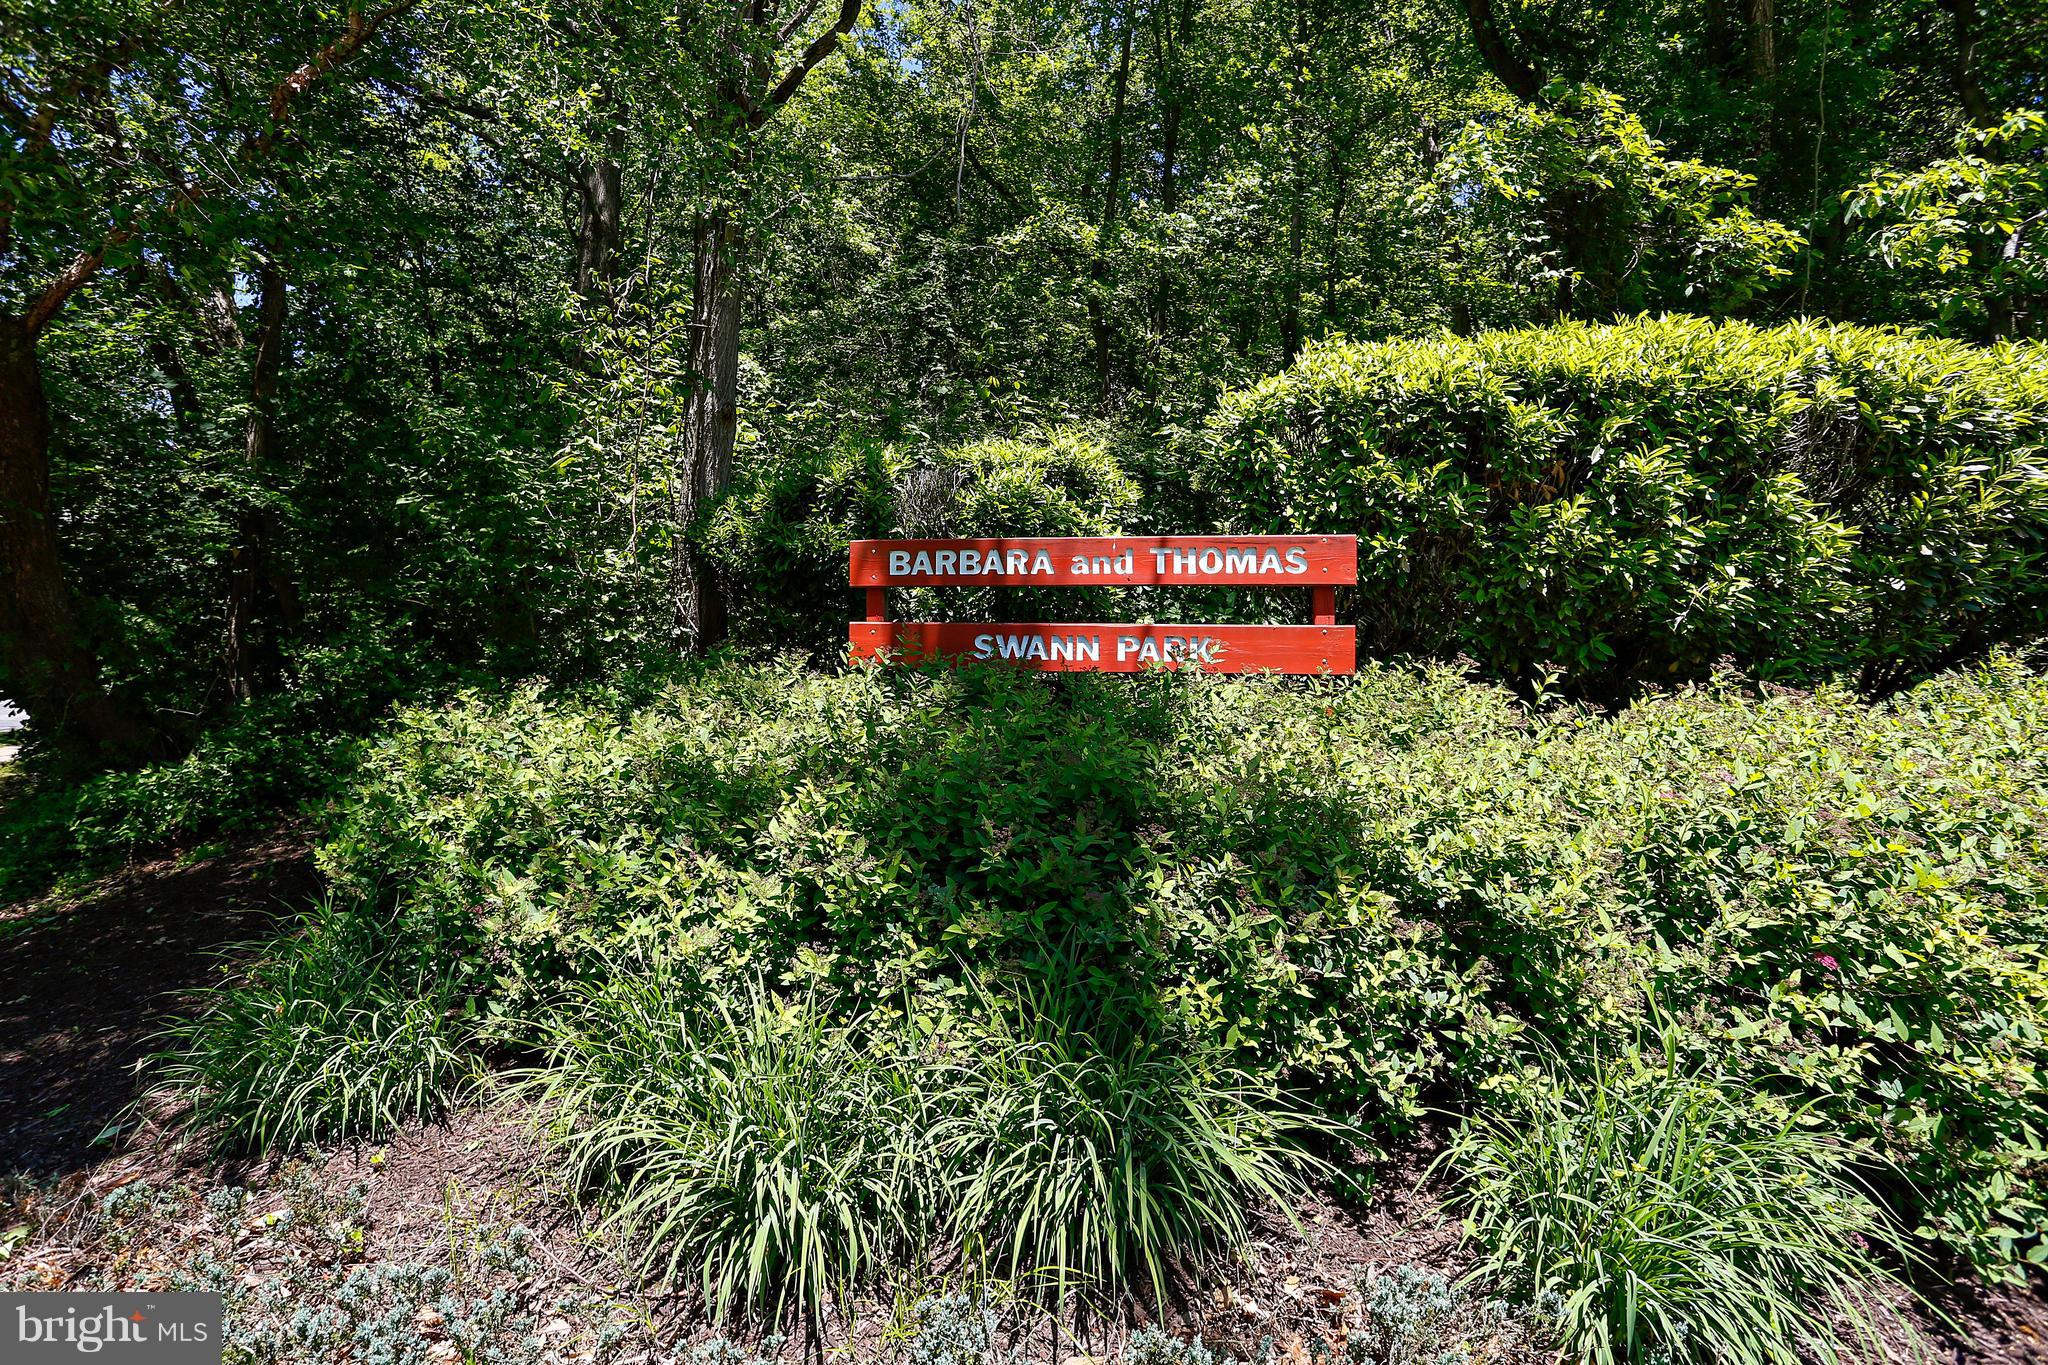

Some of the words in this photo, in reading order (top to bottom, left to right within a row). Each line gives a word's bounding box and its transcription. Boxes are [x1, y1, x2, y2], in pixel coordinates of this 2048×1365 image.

[888, 548, 1055, 576] BARBARA
[1070, 548, 1134, 576] and
[1149, 546, 1309, 575] THOMAS
[973, 633, 1100, 662] SWANN
[1116, 634, 1213, 663] PARK
